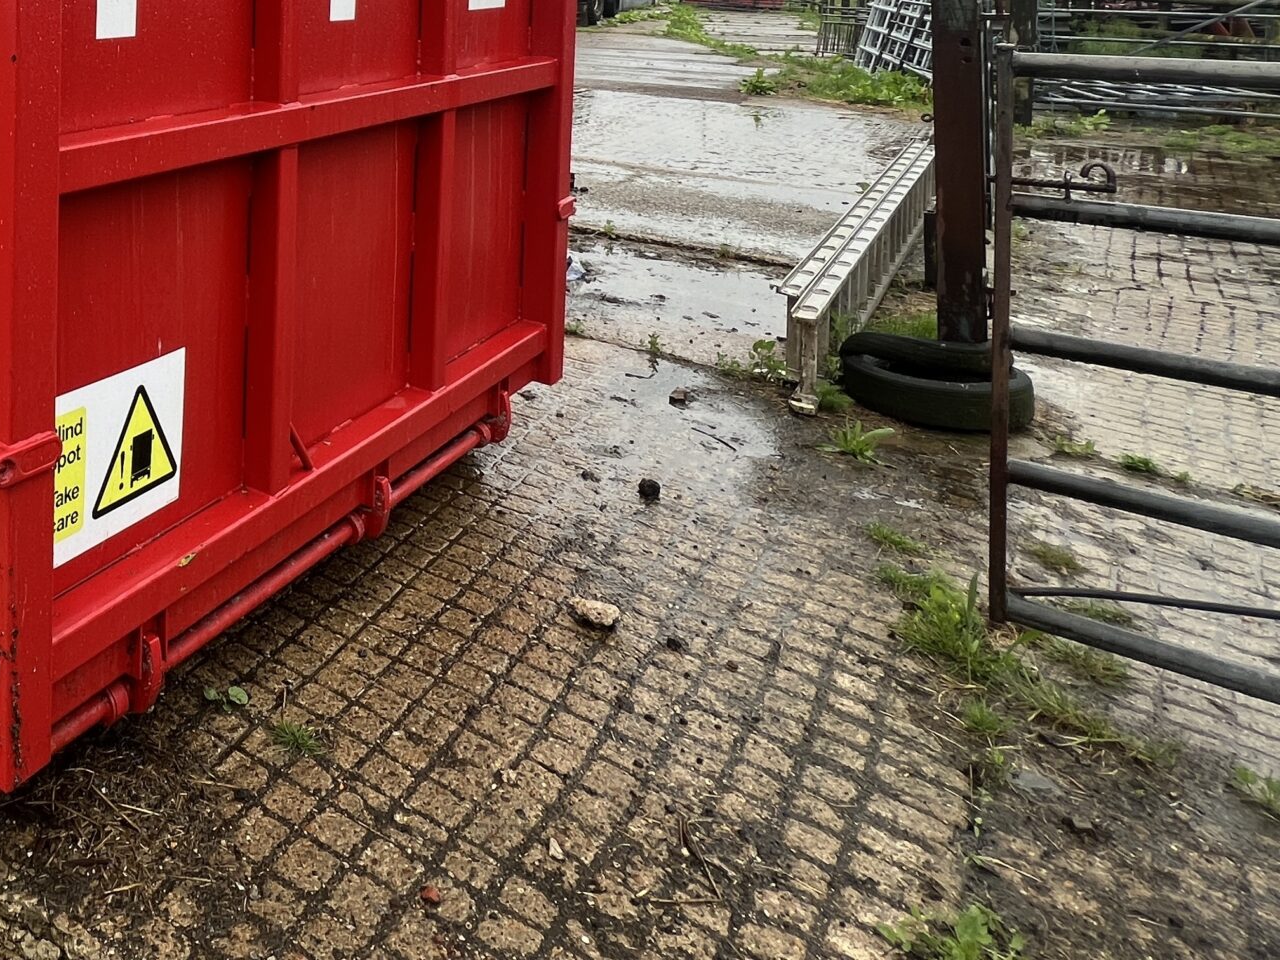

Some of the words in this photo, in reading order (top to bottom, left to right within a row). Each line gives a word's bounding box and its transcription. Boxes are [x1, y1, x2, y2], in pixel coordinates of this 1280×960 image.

[55, 416, 83, 442] lind
[54, 443, 82, 474] pot
[53, 510, 79, 532] are
